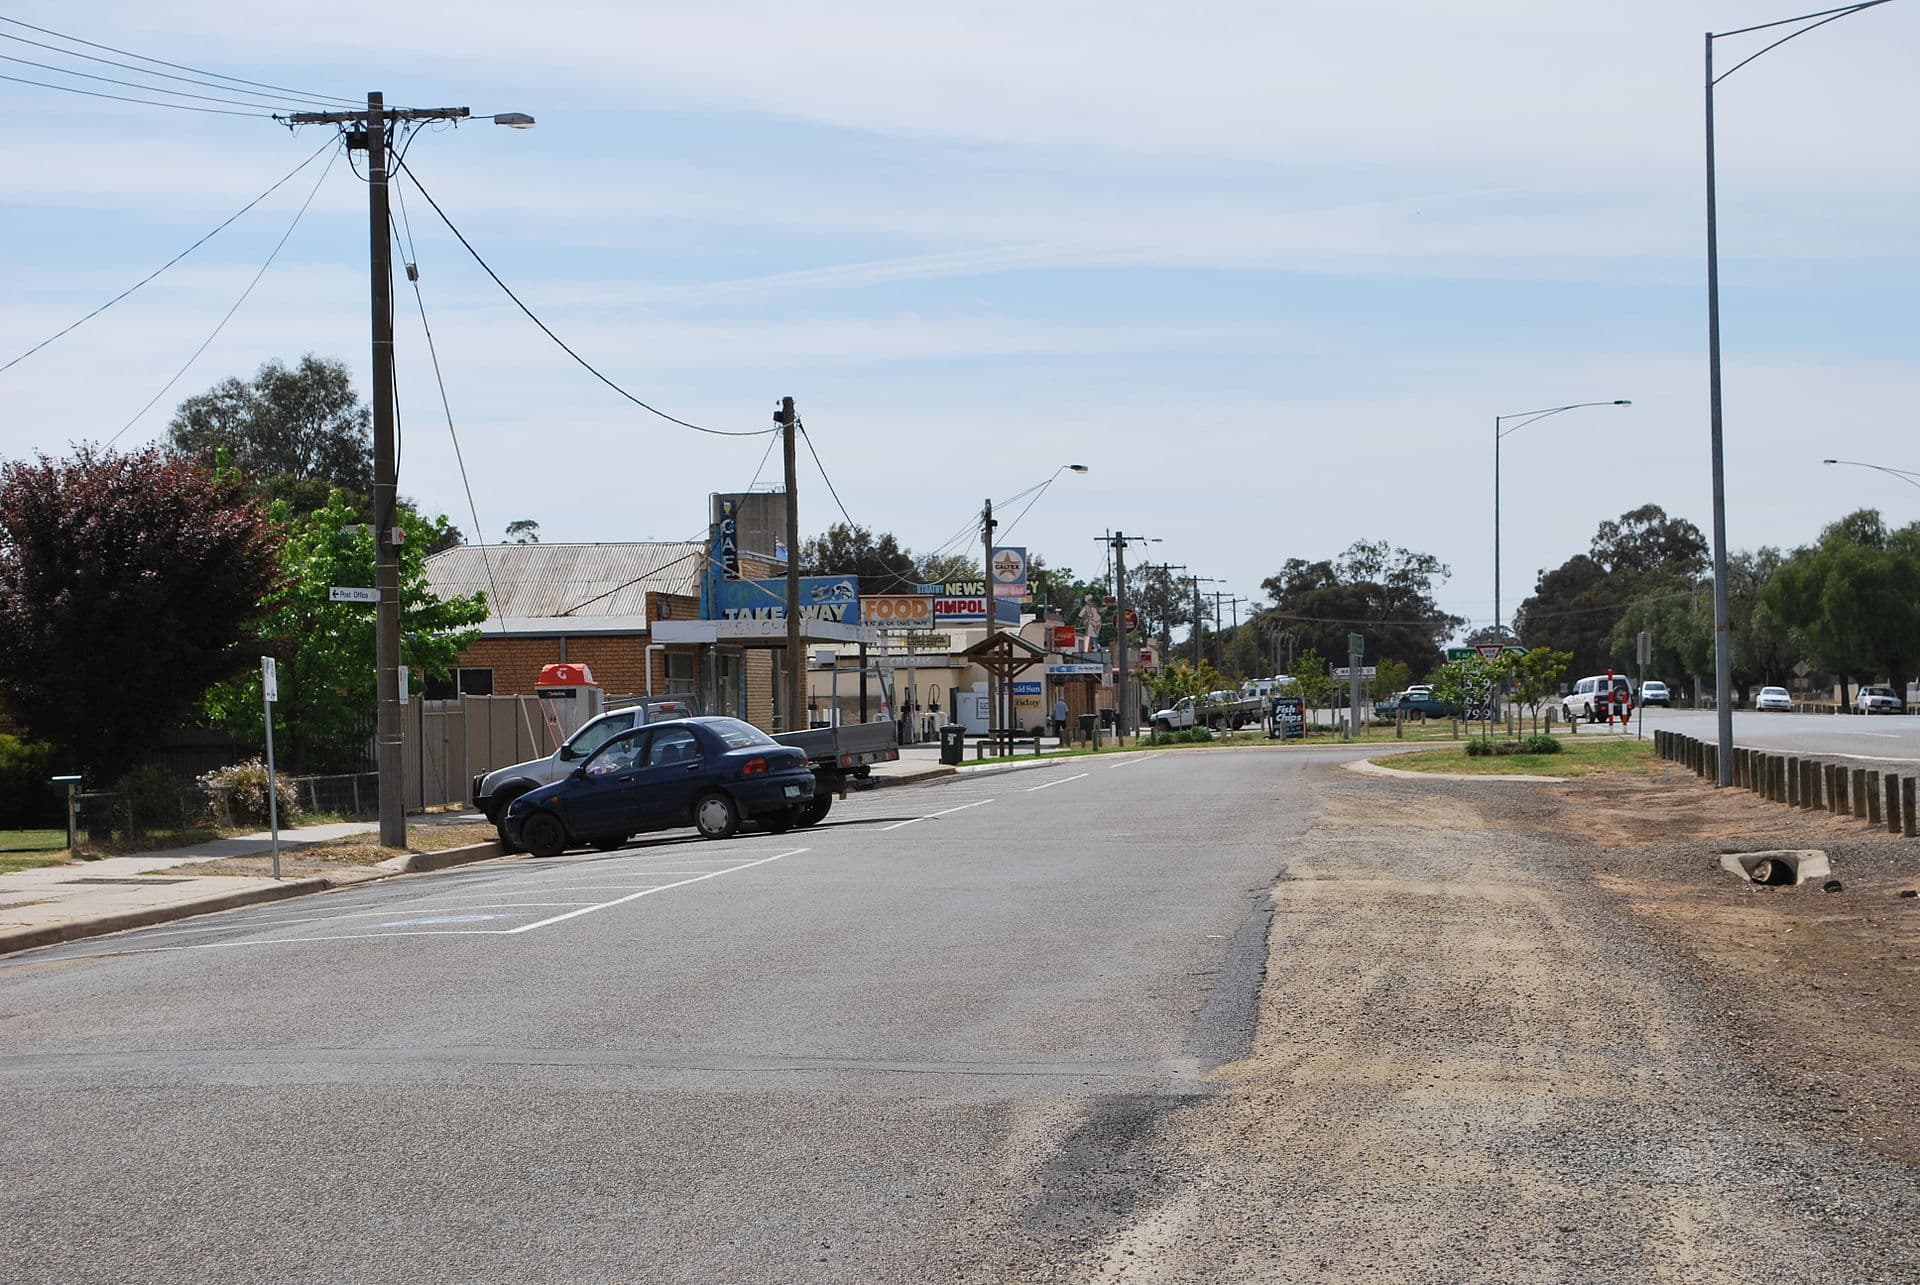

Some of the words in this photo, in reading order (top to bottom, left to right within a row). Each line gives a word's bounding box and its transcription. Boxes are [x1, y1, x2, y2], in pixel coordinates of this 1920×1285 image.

[340, 590, 352, 598] Post
[353, 591, 369, 599] Office
[865, 600, 928, 621] FOOD
[935, 600, 986, 614] AMPOL
[1026, 685, 1041, 693] Sun
[1275, 704, 1296, 714] Fish
[1275, 713, 1302, 723] Chips
